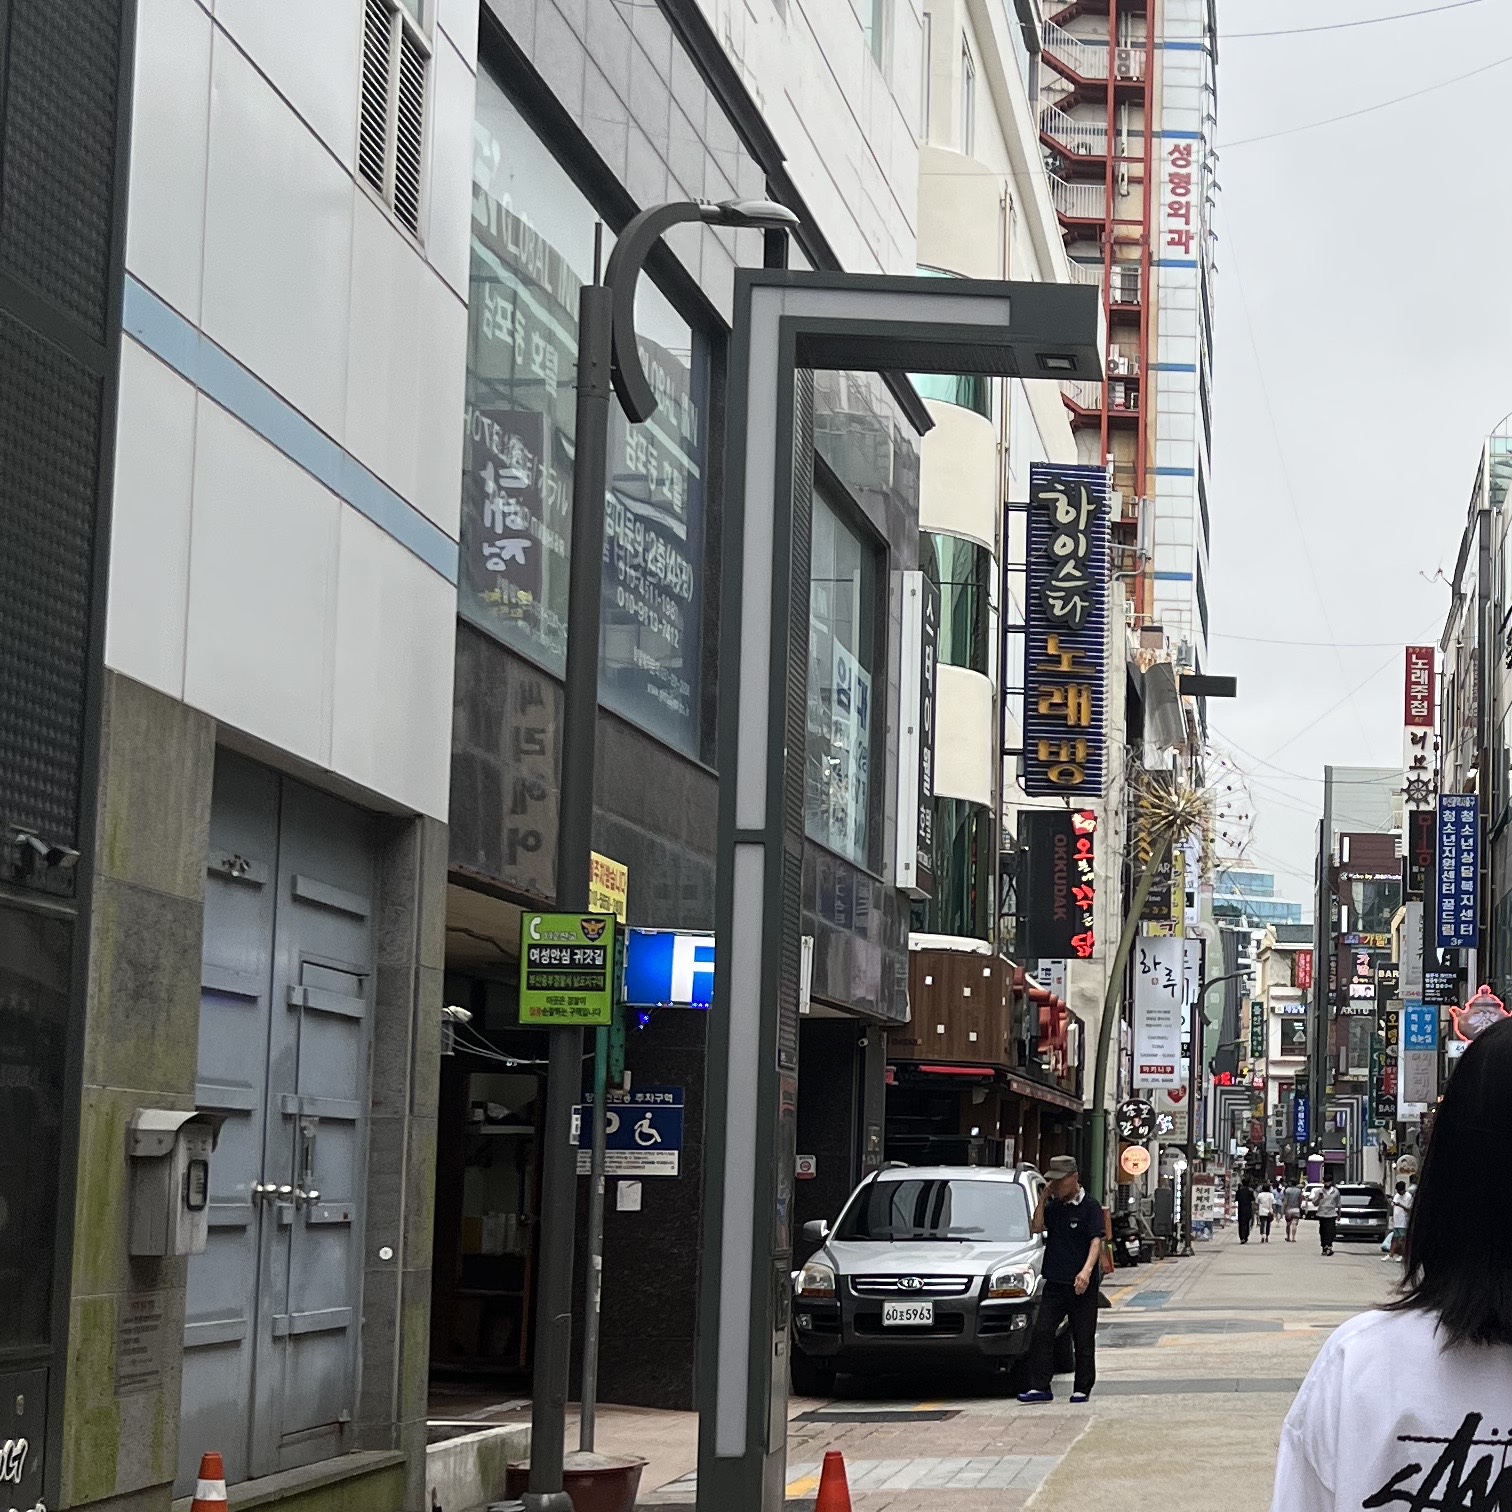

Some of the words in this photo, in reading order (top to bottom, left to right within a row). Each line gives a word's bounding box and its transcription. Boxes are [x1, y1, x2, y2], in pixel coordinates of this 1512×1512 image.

[1037, 483, 1096, 624] 하이스타
[1037, 634, 1096, 786] 노래방
[1410, 654, 1430, 717] 노래주점
[1054, 834, 1066, 920] OKKUDAK
[529, 948, 570, 964] 여성안심
[573, 949, 604, 965] 귀갓길
[1140, 949, 1177, 997] 하루
[1378, 970, 1399, 978] BAR
[635, 1093, 673, 1103] 주차구역
